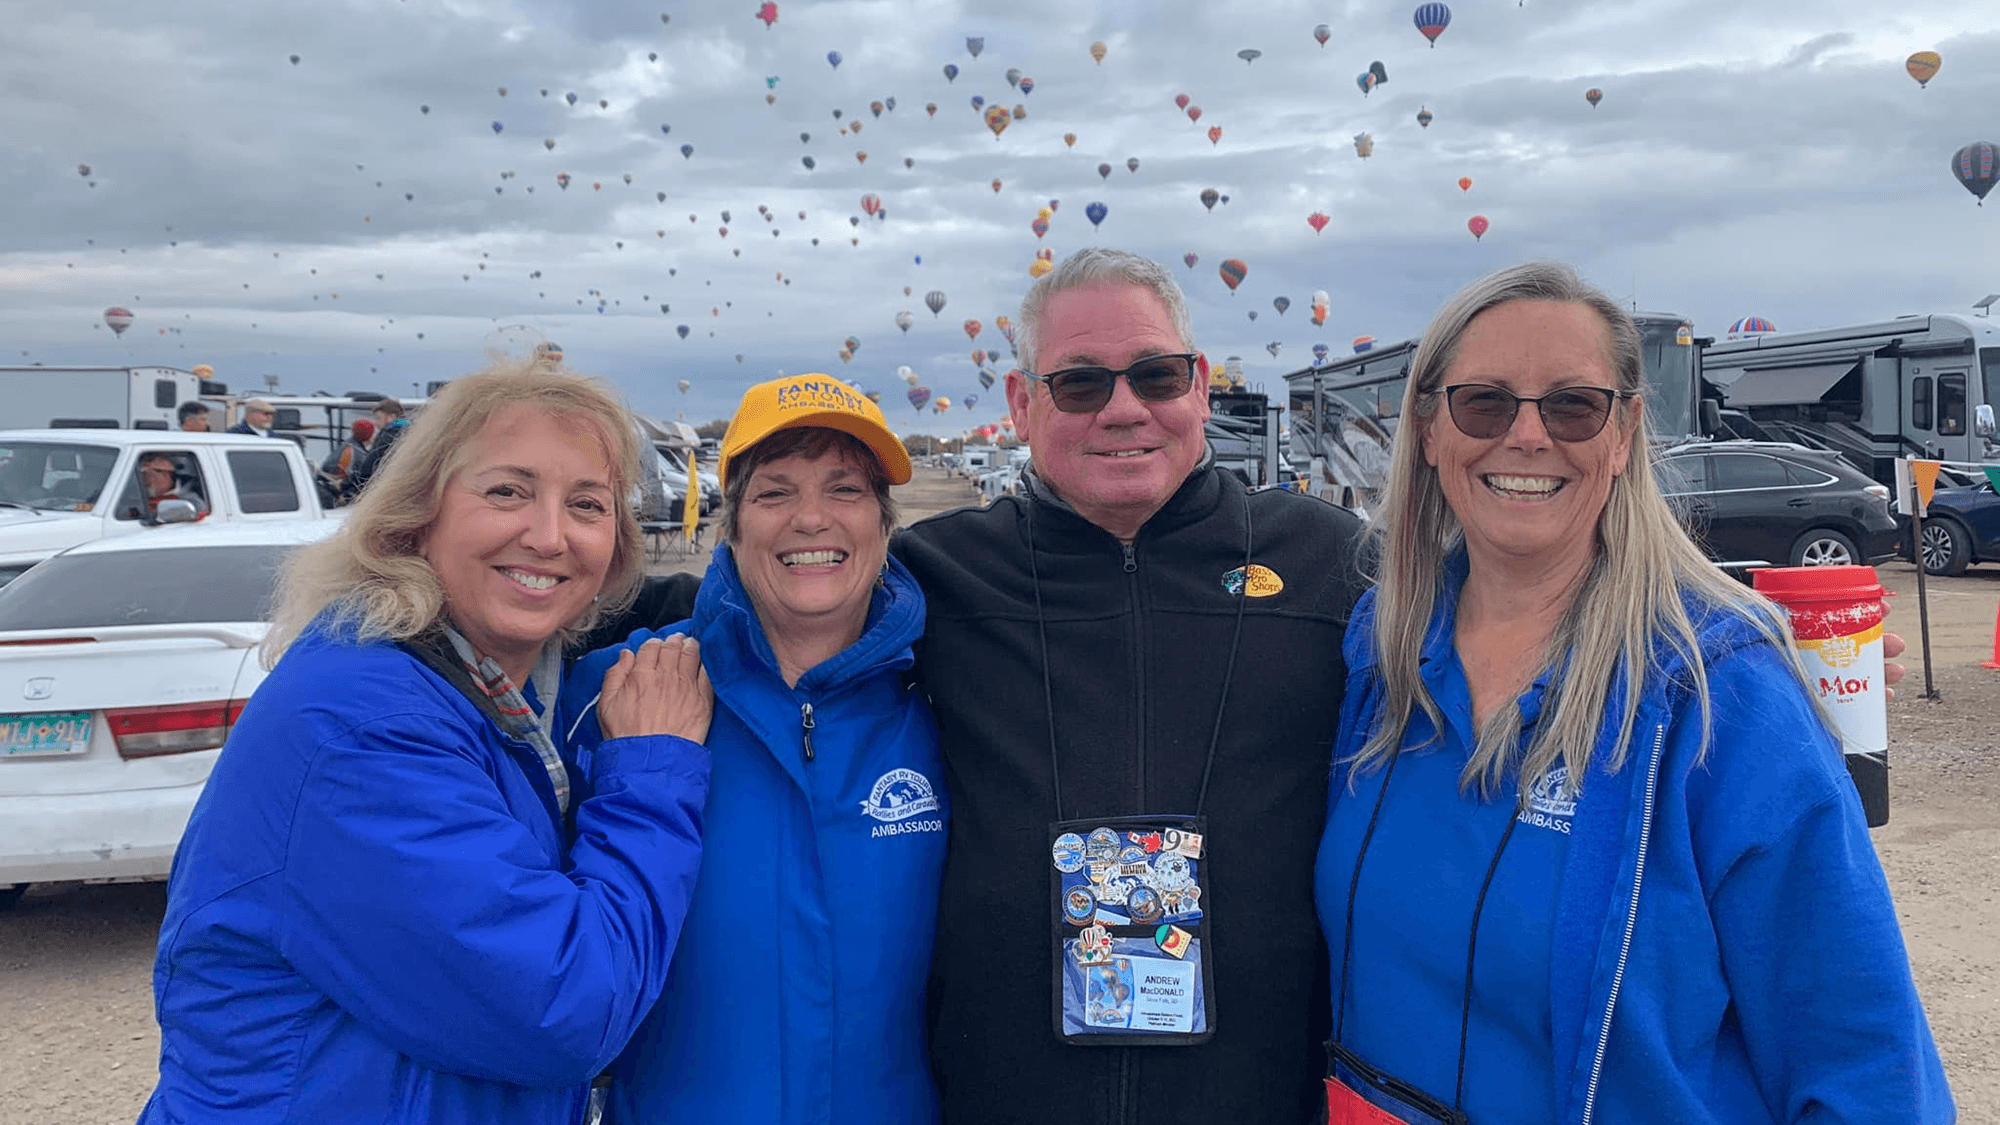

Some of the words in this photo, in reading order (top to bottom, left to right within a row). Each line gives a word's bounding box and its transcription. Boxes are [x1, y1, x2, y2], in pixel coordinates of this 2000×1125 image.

[778, 382, 862, 409] FANTASY
[778, 393, 801, 405] RV
[1249, 565, 1272, 575] Bass
[1250, 573, 1268, 582] Pro
[1251, 581, 1280, 592] Shops
[873, 772, 897, 801] FANTASY
[898, 771, 909, 780] RV
[897, 804, 912, 818] and
[1516, 809, 1572, 835] AMBASS
[871, 820, 943, 839] AMBASSADOR
[1165, 829, 1182, 851] 9
[1144, 975, 1181, 986] ANDREW
[1140, 986, 1185, 997] MacDONALD
